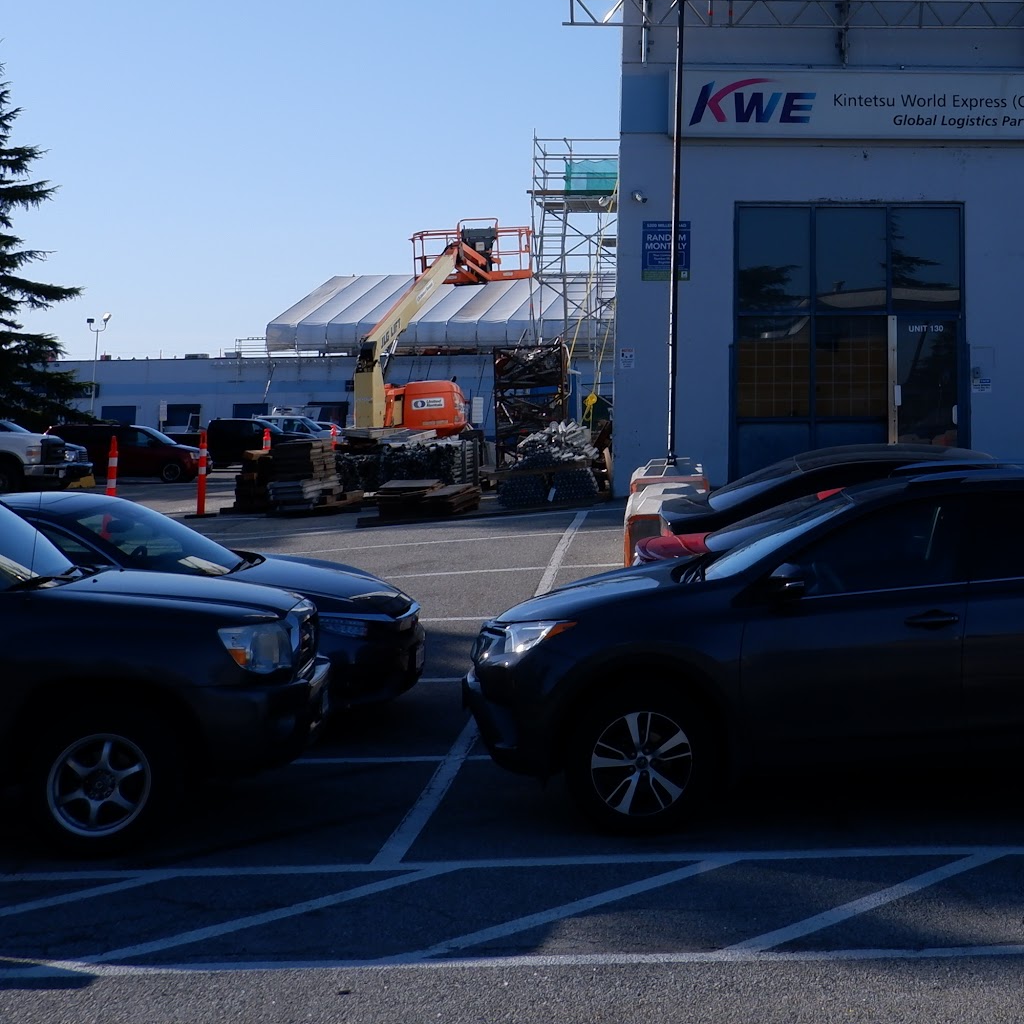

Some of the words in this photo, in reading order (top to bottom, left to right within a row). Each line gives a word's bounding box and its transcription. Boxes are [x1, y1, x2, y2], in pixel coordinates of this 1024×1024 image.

[689, 78, 816, 126] KWE
[833, 93, 895, 108] Kintetsu
[901, 93, 946, 108] World
[953, 95, 1007, 111] Express
[893, 115, 937, 127] Global
[941, 115, 998, 129] Logistics
[645, 242, 687, 250] MONTLY
[908, 325, 928, 333] UNIT
[930, 325, 944, 333] 130
